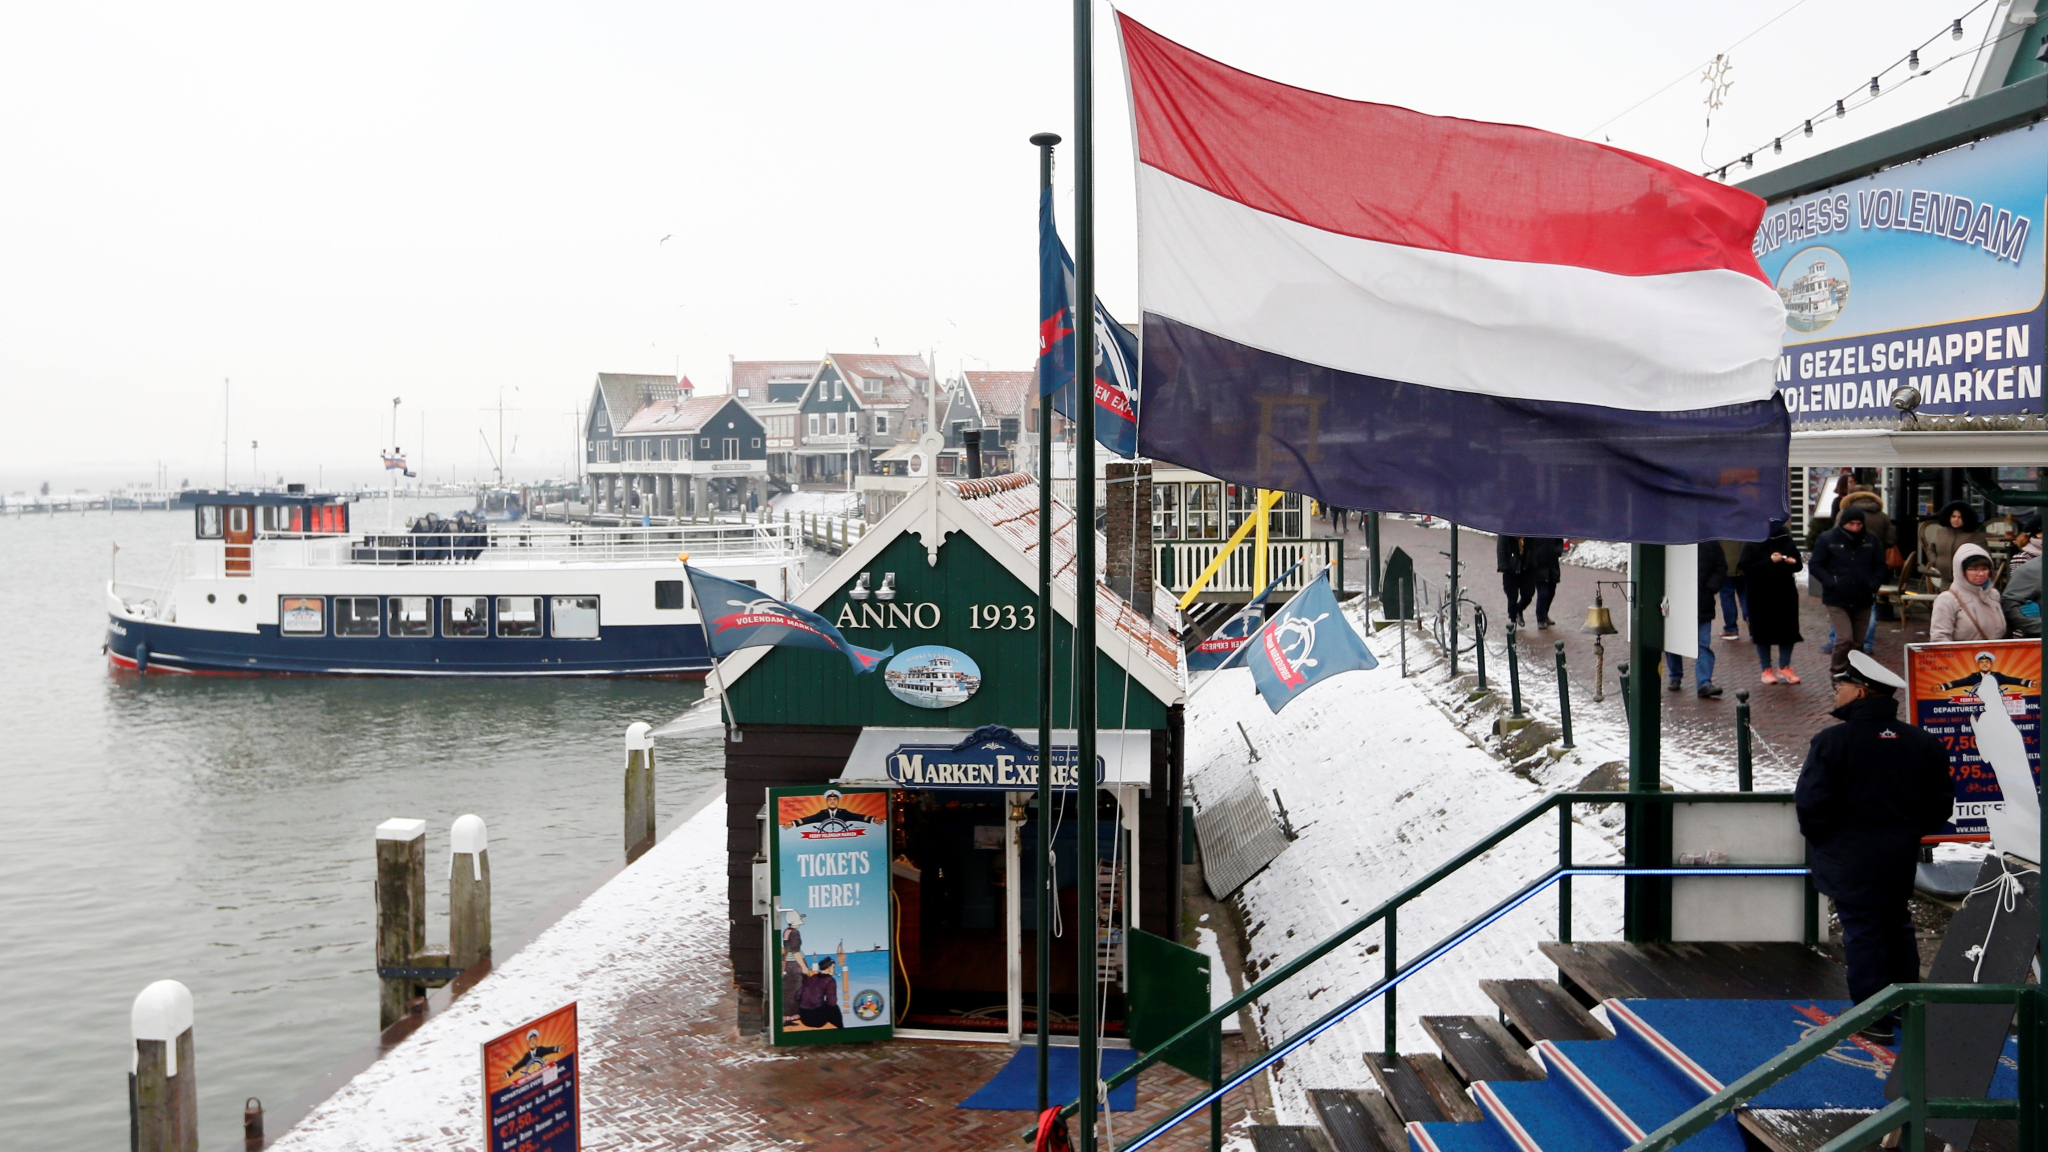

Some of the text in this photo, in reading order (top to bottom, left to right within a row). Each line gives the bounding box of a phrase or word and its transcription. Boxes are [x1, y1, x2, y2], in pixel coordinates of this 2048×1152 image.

[1858, 189, 2030, 263] VOLENDAM
[1800, 324, 2029, 380] GEZELSCHAPPEN
[1908, 364, 2042, 406] MARKEN
[736, 615, 821, 635] VOLENDAM MARKE
[835, 602, 1036, 631] ANNO 1933
[1933, 706, 1978, 714] DEPARTURES
[898, 754, 1078, 786] MARKEN EXPRES
[797, 851, 870, 878] TICKETS
[808, 883, 861, 909] HERE!
